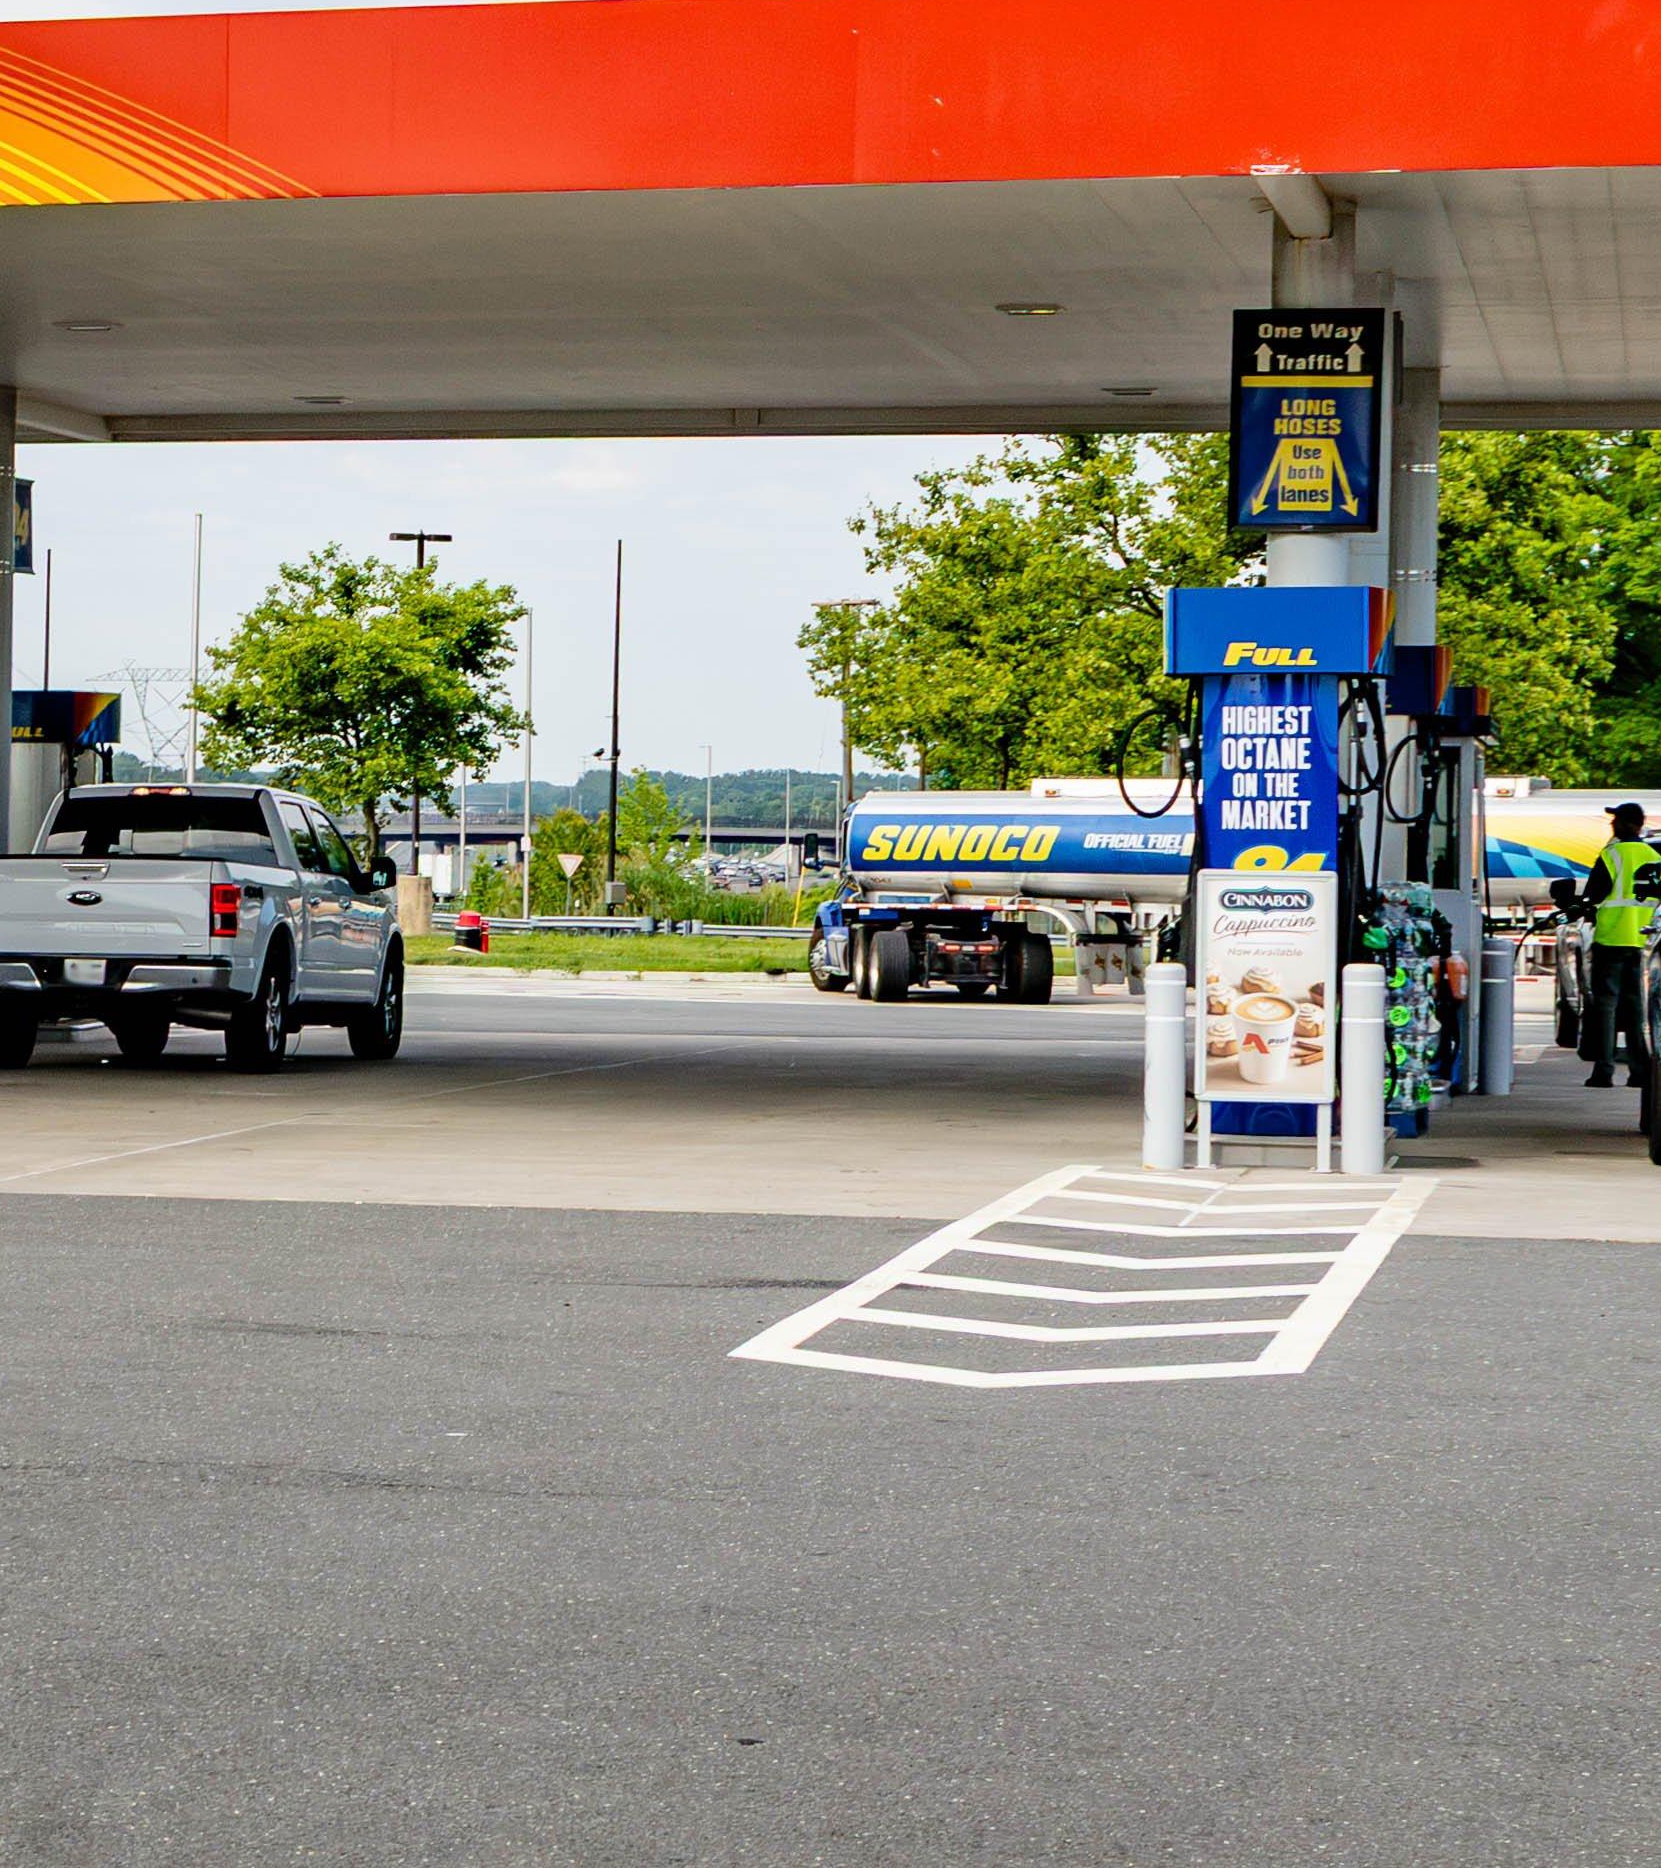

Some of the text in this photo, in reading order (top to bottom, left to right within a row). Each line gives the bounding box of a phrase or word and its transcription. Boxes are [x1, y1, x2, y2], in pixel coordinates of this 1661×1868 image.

[1258, 323, 1364, 342] One Way
[1276, 354, 1345, 371] Traffic
[1281, 398, 1336, 416] LONG
[1273, 418, 1342, 435] HOSES
[1292, 444, 1322, 459] Use
[1287, 465, 1325, 480] both
[1280, 486, 1329, 503] lanes
[1223, 642, 1318, 666] FULL
[1221, 706, 1312, 735] HIGHEST
[12, 726, 45, 738] ULL
[1221, 737, 1312, 770] OCTANE
[1232, 772, 1299, 798] ON THE
[1221, 800, 1312, 830] MARKET
[861, 825, 1062, 862] SUNOCO
[1083, 833, 1182, 849] OFFICIAL FUEL
[1223, 893, 1308, 908] CINNABON
[1213, 914, 1317, 936] Cappuccino
[1227, 947, 1304, 957] Now Available
